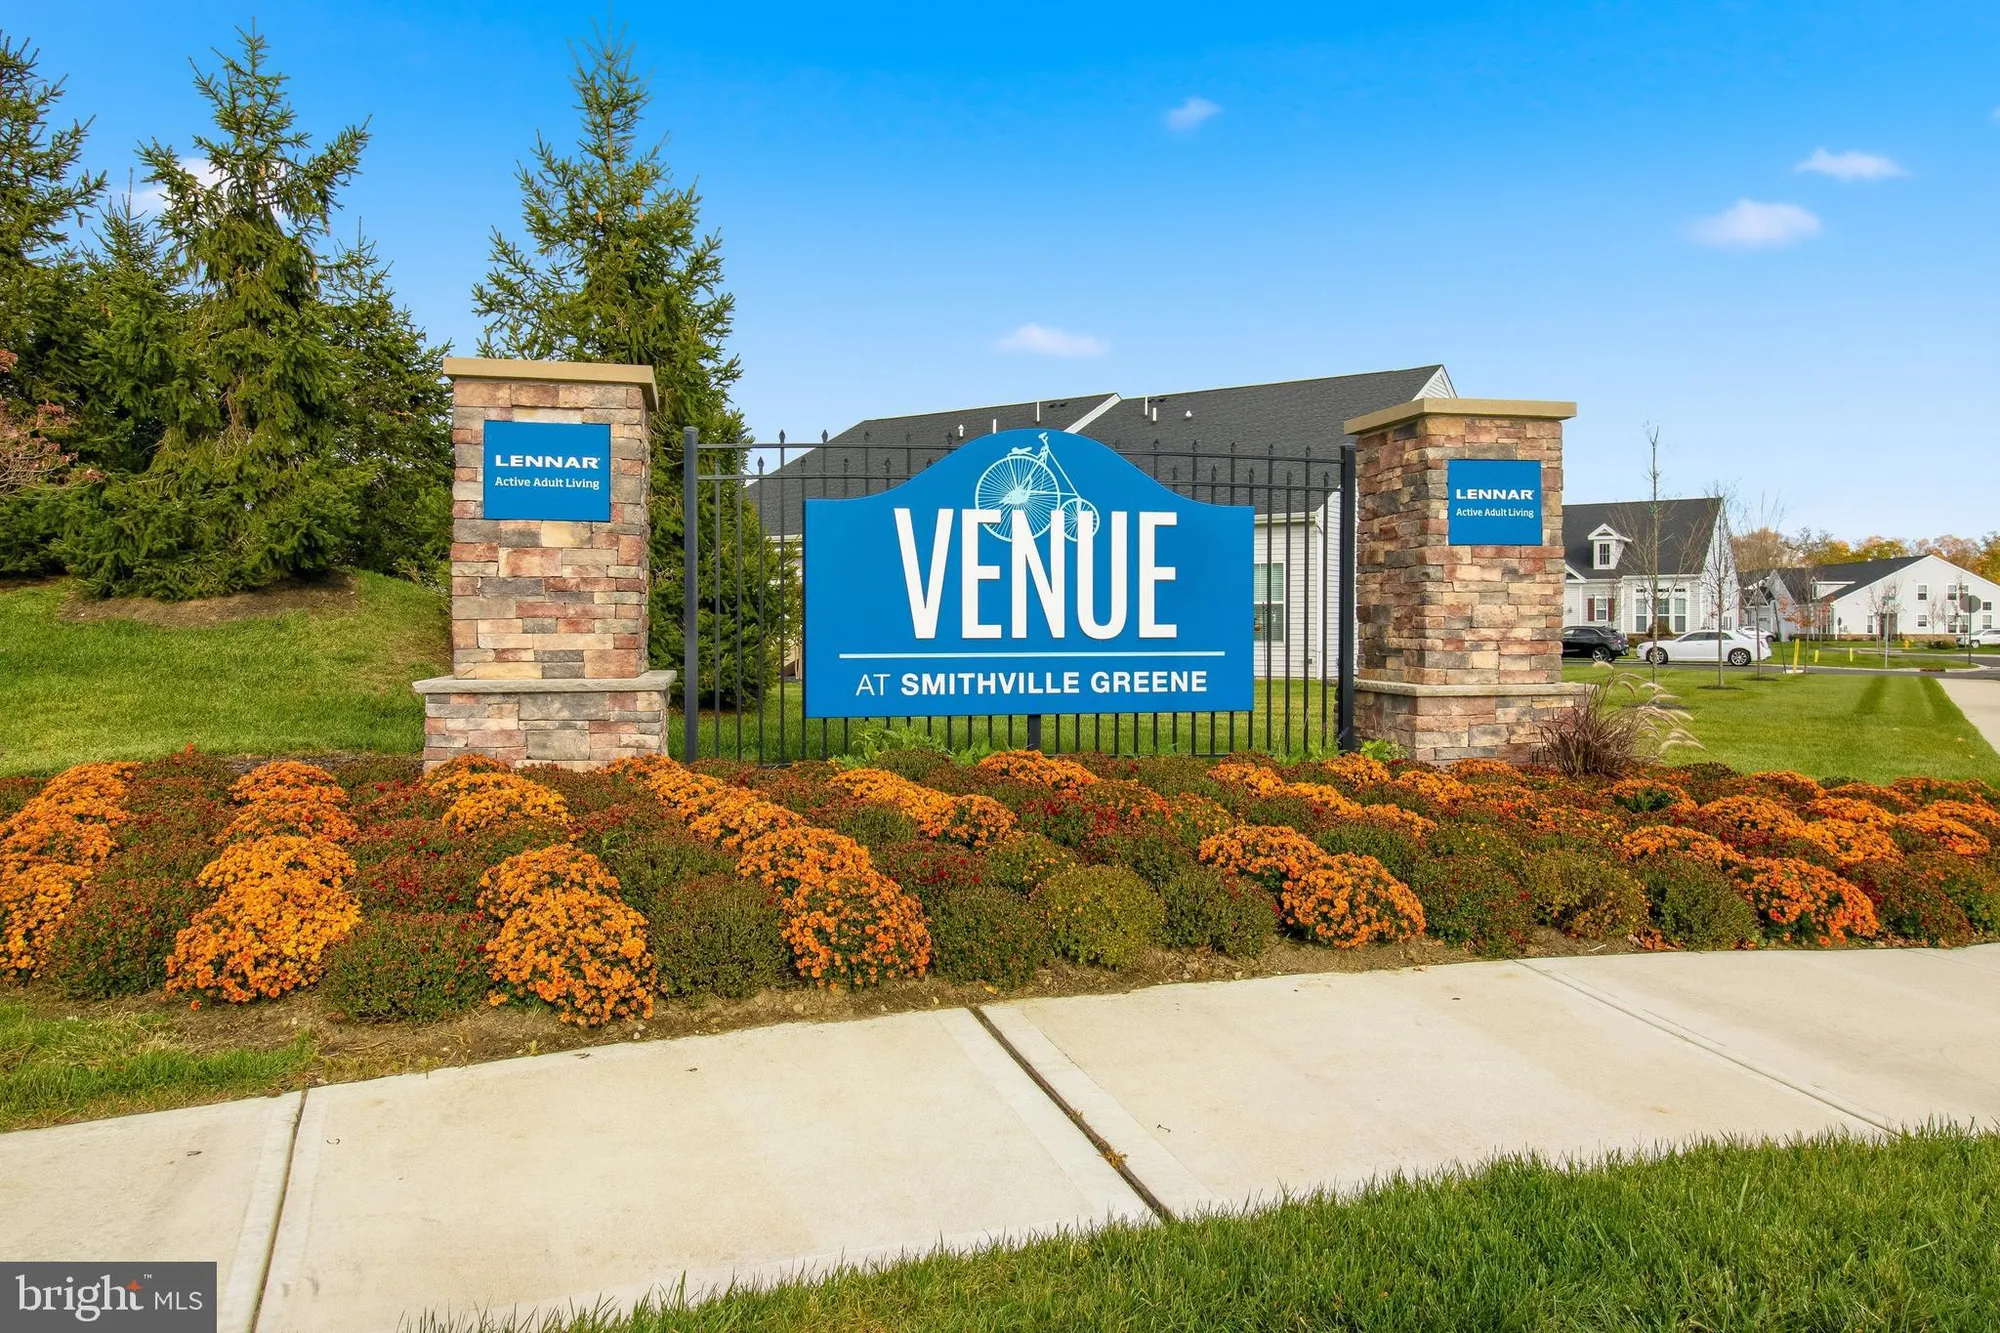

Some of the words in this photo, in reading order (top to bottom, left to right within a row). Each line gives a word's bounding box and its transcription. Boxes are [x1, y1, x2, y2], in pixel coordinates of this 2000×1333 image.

[495, 454, 600, 469] LENNAR
[495, 476, 531, 487] Active
[533, 477, 563, 488] Adult
[565, 478, 600, 490] Living
[1456, 488, 1534, 500] LENNAR
[1456, 508, 1483, 517] Active
[1484, 508, 1507, 517] Adult
[1508, 508, 1534, 519] Living
[893, 508, 1177, 639] VENUE
[855, 673, 891, 697] AT
[901, 672, 1080, 696] SMITHVILLE
[1090, 671, 1208, 694] GREENE
